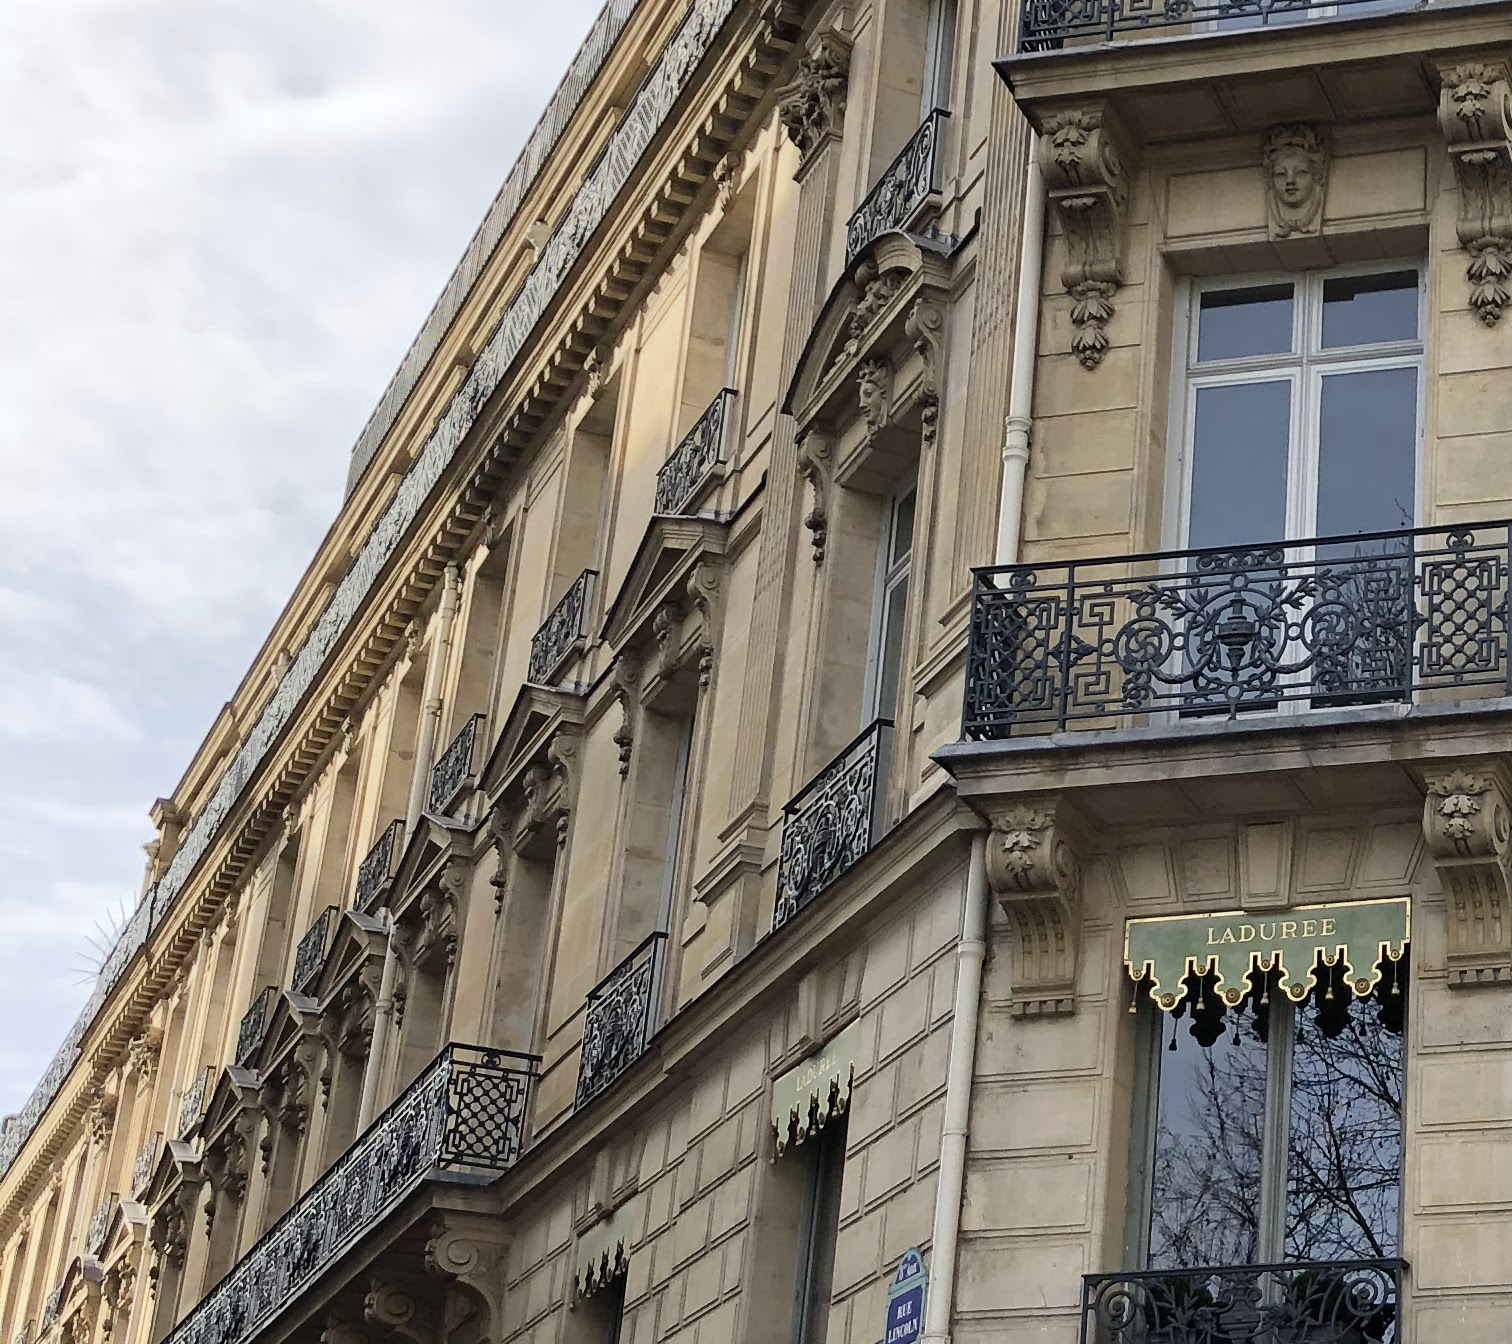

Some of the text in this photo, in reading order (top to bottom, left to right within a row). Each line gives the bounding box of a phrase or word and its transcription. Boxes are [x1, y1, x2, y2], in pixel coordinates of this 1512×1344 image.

[1206, 918, 1337, 946] LADUREE
[896, 1300, 913, 1320] RUE
[888, 1317, 919, 1344] LINCOLN
